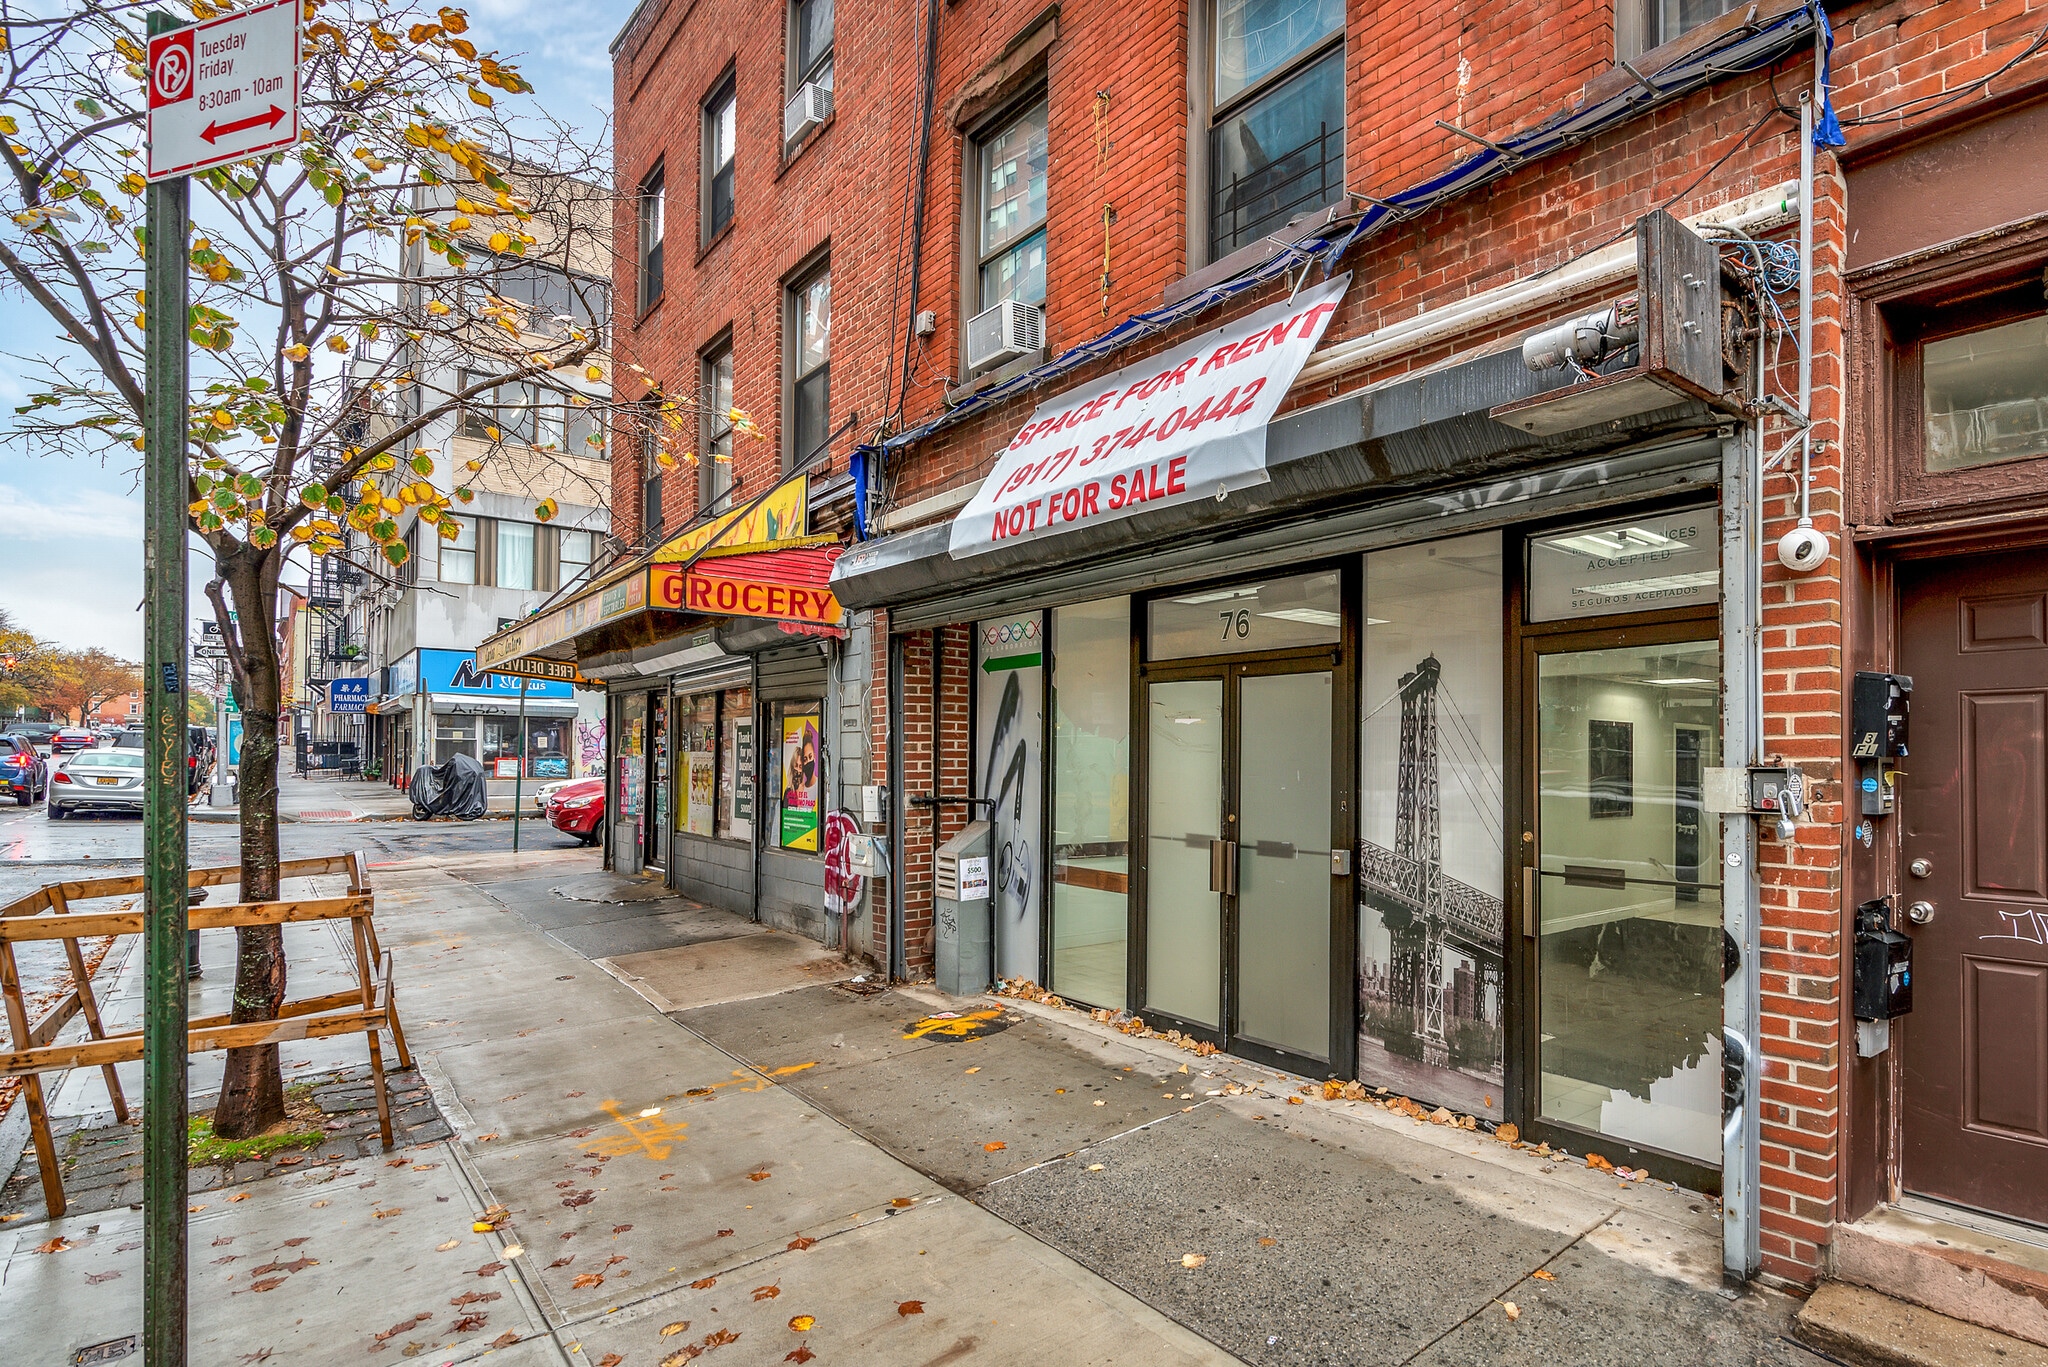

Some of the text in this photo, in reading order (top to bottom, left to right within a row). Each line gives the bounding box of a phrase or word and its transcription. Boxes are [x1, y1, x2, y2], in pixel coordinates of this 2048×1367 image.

[200, 33, 247, 58] Tuesday
[199, 58, 234, 80] Friday
[199, 88, 241, 111] 8:30am
[253, 76, 283, 96] 10am
[1010, 302, 1338, 451] SPACE FOR RENT
[993, 376, 1267, 503] (917) 374-0442
[991, 455, 1188, 541] NOT FOR SALE
[1587, 550, 1671, 570] ACCEPTED
[663, 574, 833, 620] GROCERY
[1572, 586, 1699, 608] SEGUROS ACEPTADOS
[1219, 608, 1250, 640] 76
[334, 694, 369, 702] PHARMACY
[334, 703, 366, 711] FARMACI
[1855, 745, 1874, 755] FL
[1864, 733, 1873, 744] 3
